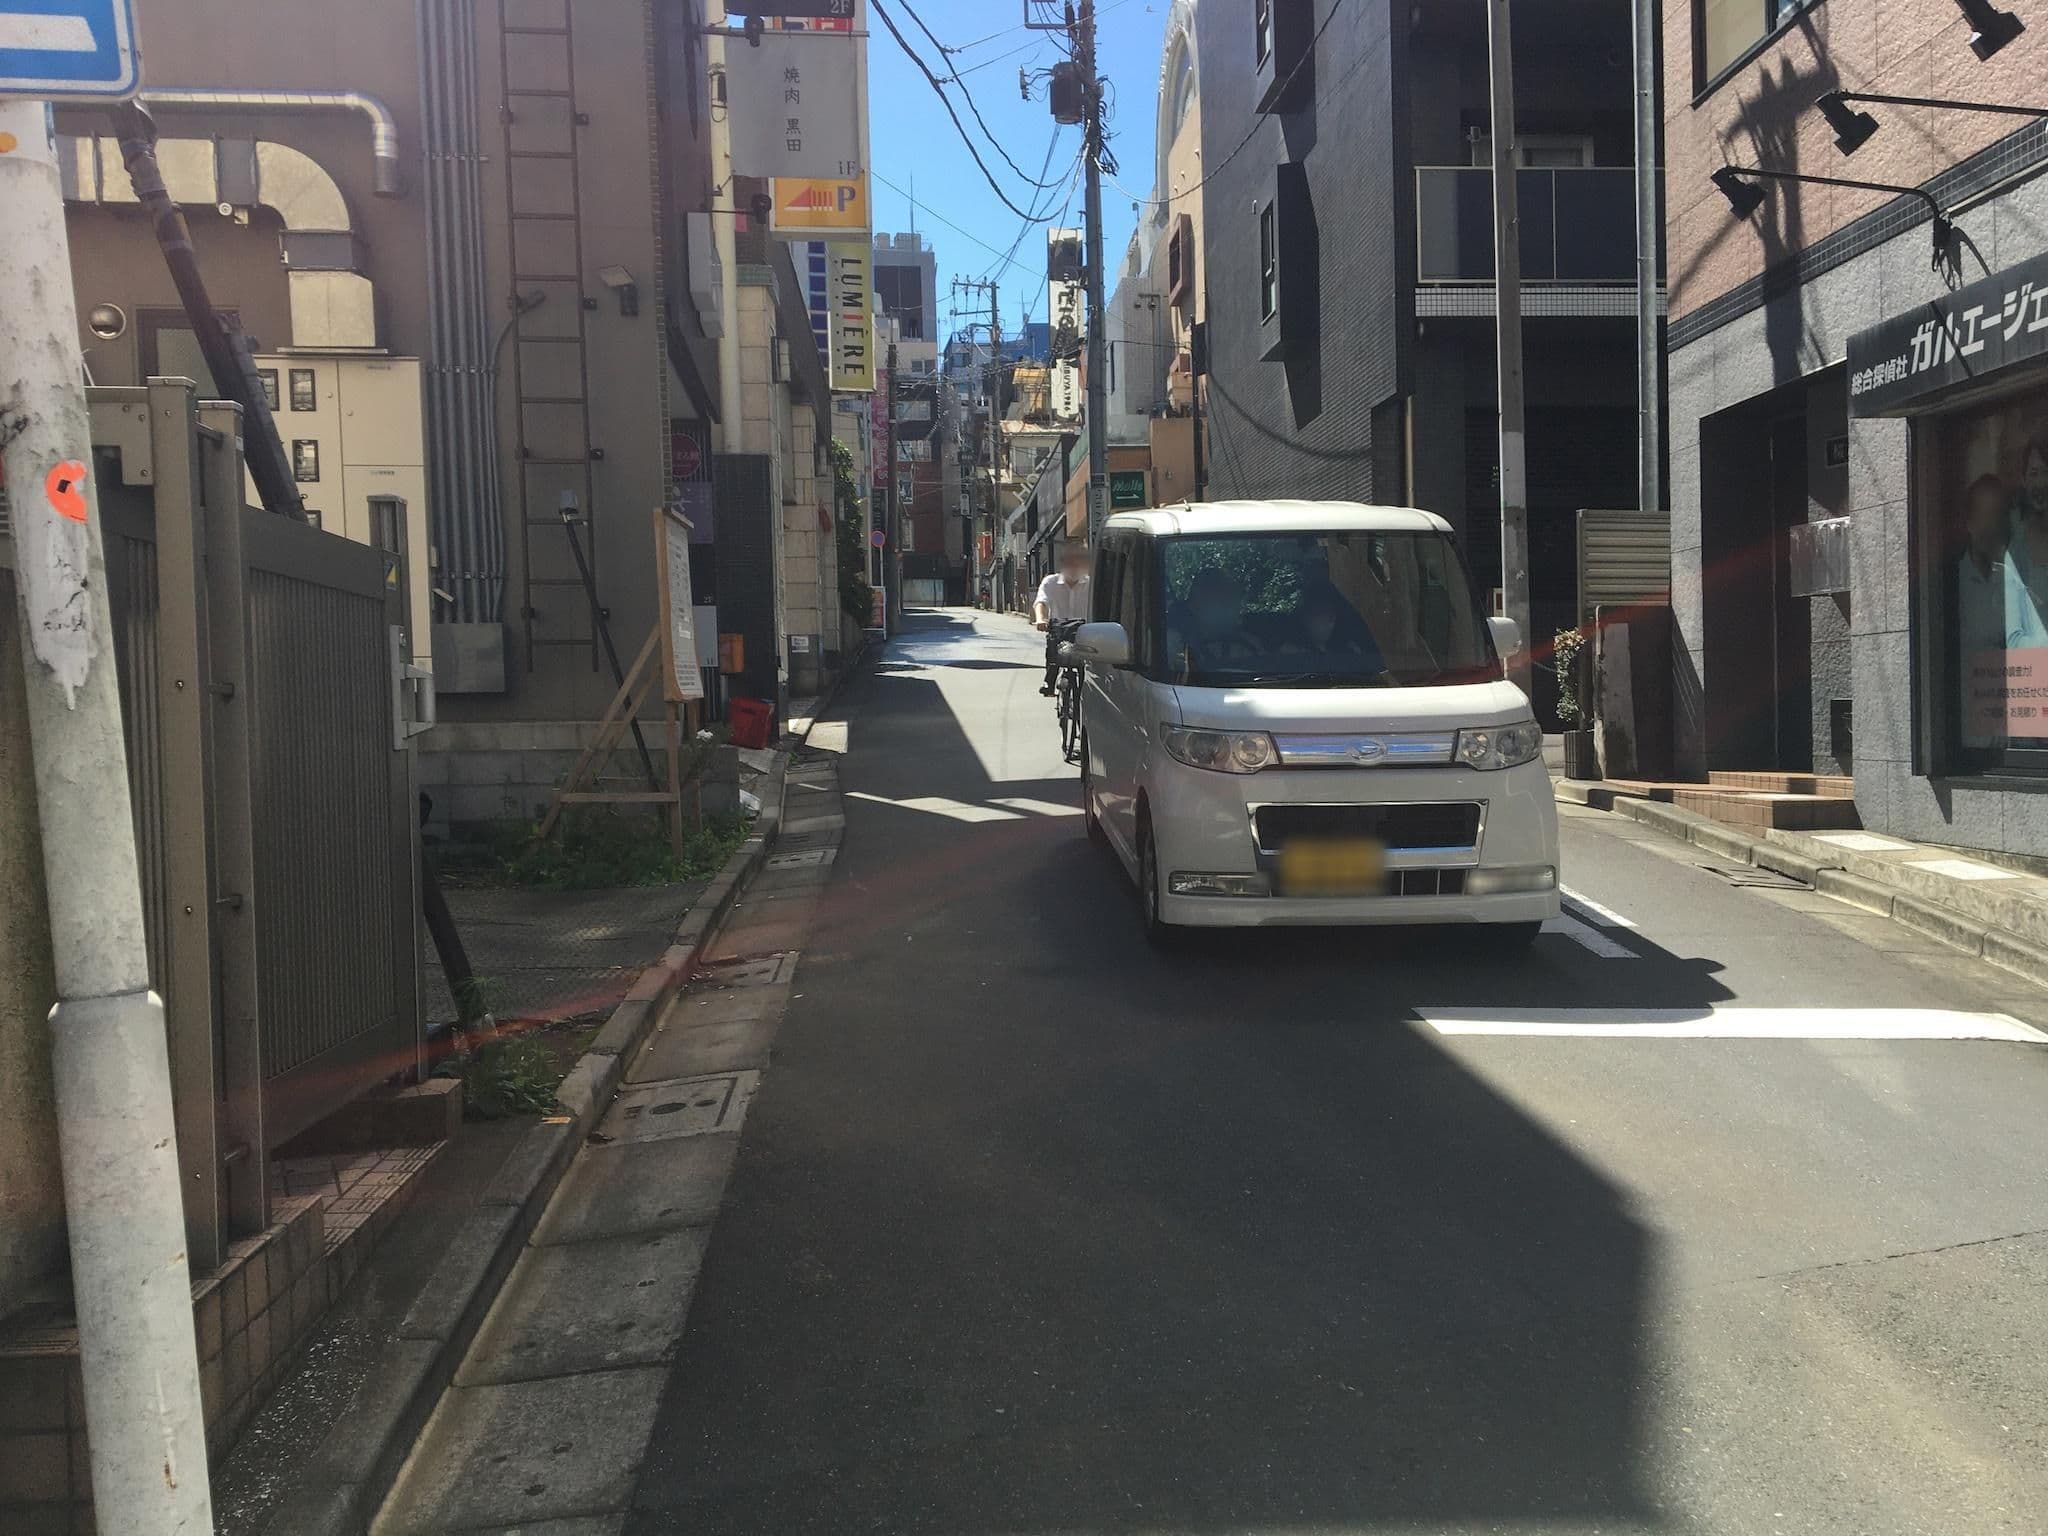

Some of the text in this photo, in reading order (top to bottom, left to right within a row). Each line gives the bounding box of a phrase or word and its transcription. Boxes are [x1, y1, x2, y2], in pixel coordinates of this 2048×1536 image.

[831, 0, 849, 14] 2F
[784, 66, 802, 152] 焼肉 黒田
[837, 186, 856, 212] P
[1851, 354, 1908, 396] 総合探偵社
